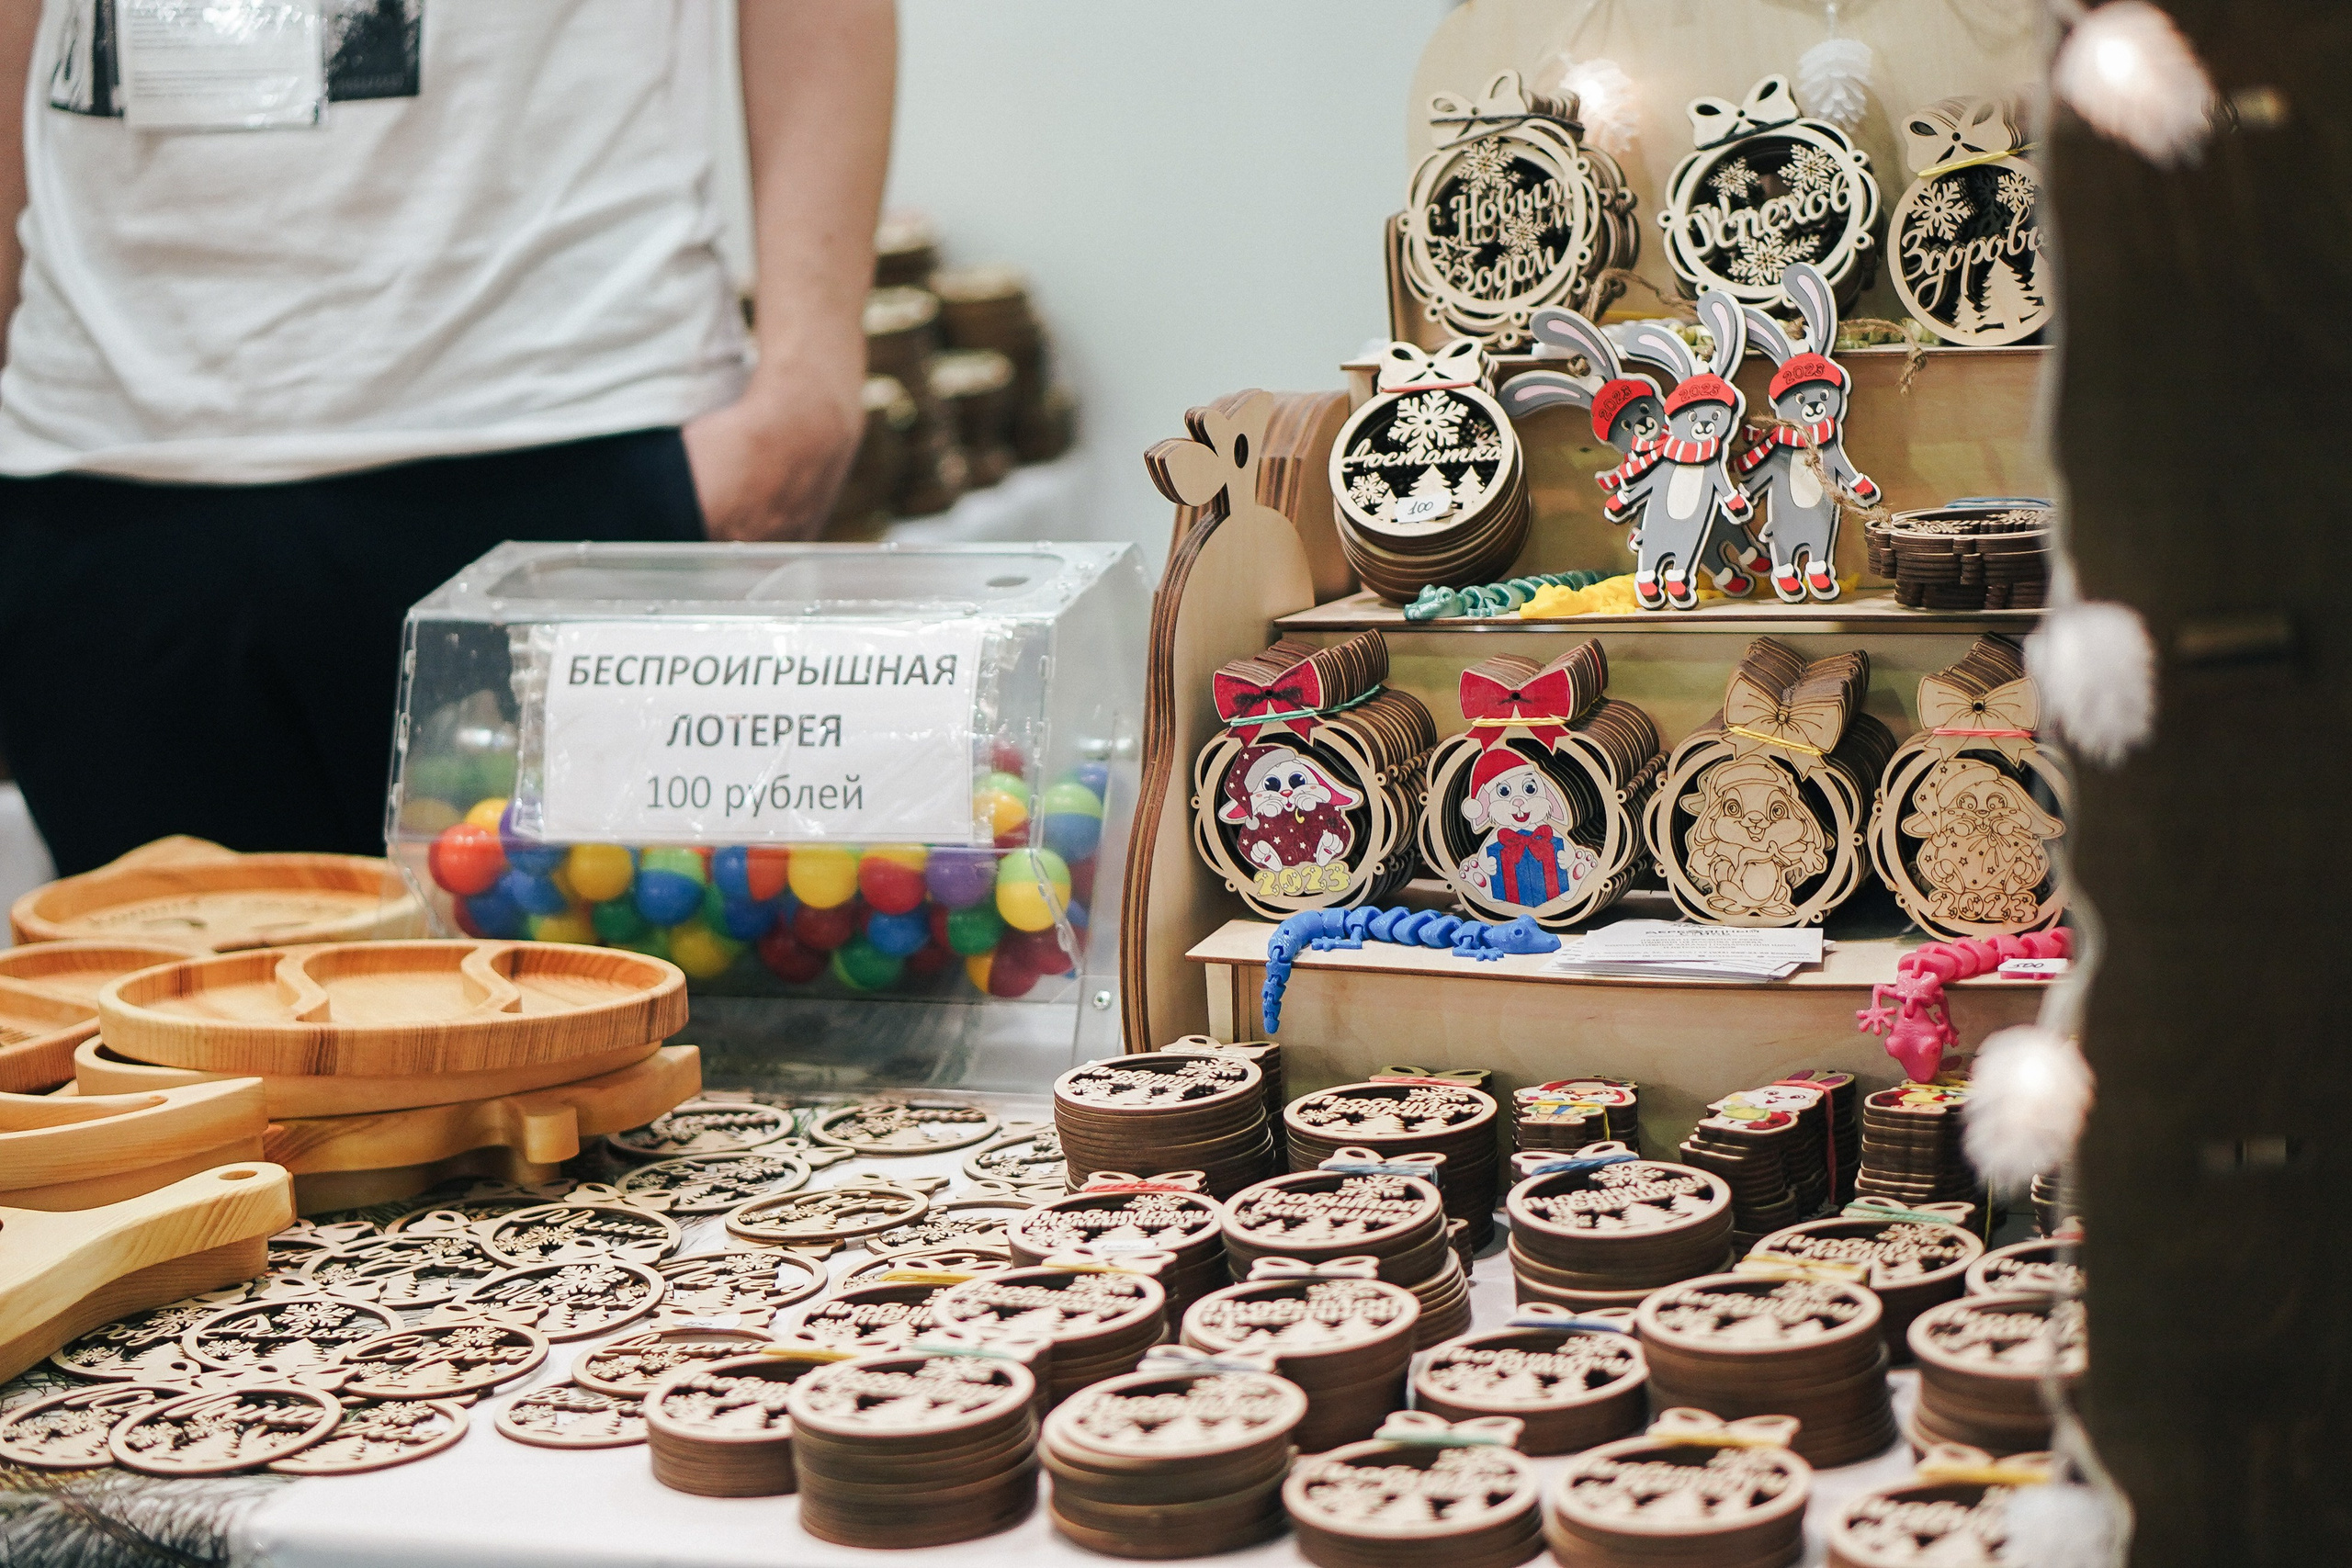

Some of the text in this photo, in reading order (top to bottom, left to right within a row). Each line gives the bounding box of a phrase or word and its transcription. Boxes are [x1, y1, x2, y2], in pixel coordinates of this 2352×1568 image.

[1449, 178, 1573, 244] Новым
[1685, 171, 1850, 254] Успехов
[1782, 362, 1825, 385] 2023
[1599, 385, 1633, 422] 2023
[1678, 382, 1722, 403] 2023
[1341, 437, 1503, 473] Достатка
[1408, 500, 1434, 515] 100
[567, 653, 958, 688] БЕСПРОИГРЫШНАЯ
[666, 713, 843, 749] ЛОТЕРЕЯ
[646, 773, 864, 818] 100 рублей
[1253, 863, 1351, 897] 2023
[1929, 890, 2040, 924] 2023
[1244, 1188, 1425, 1212] Любимой
[345, 1335, 537, 1373] Софья
